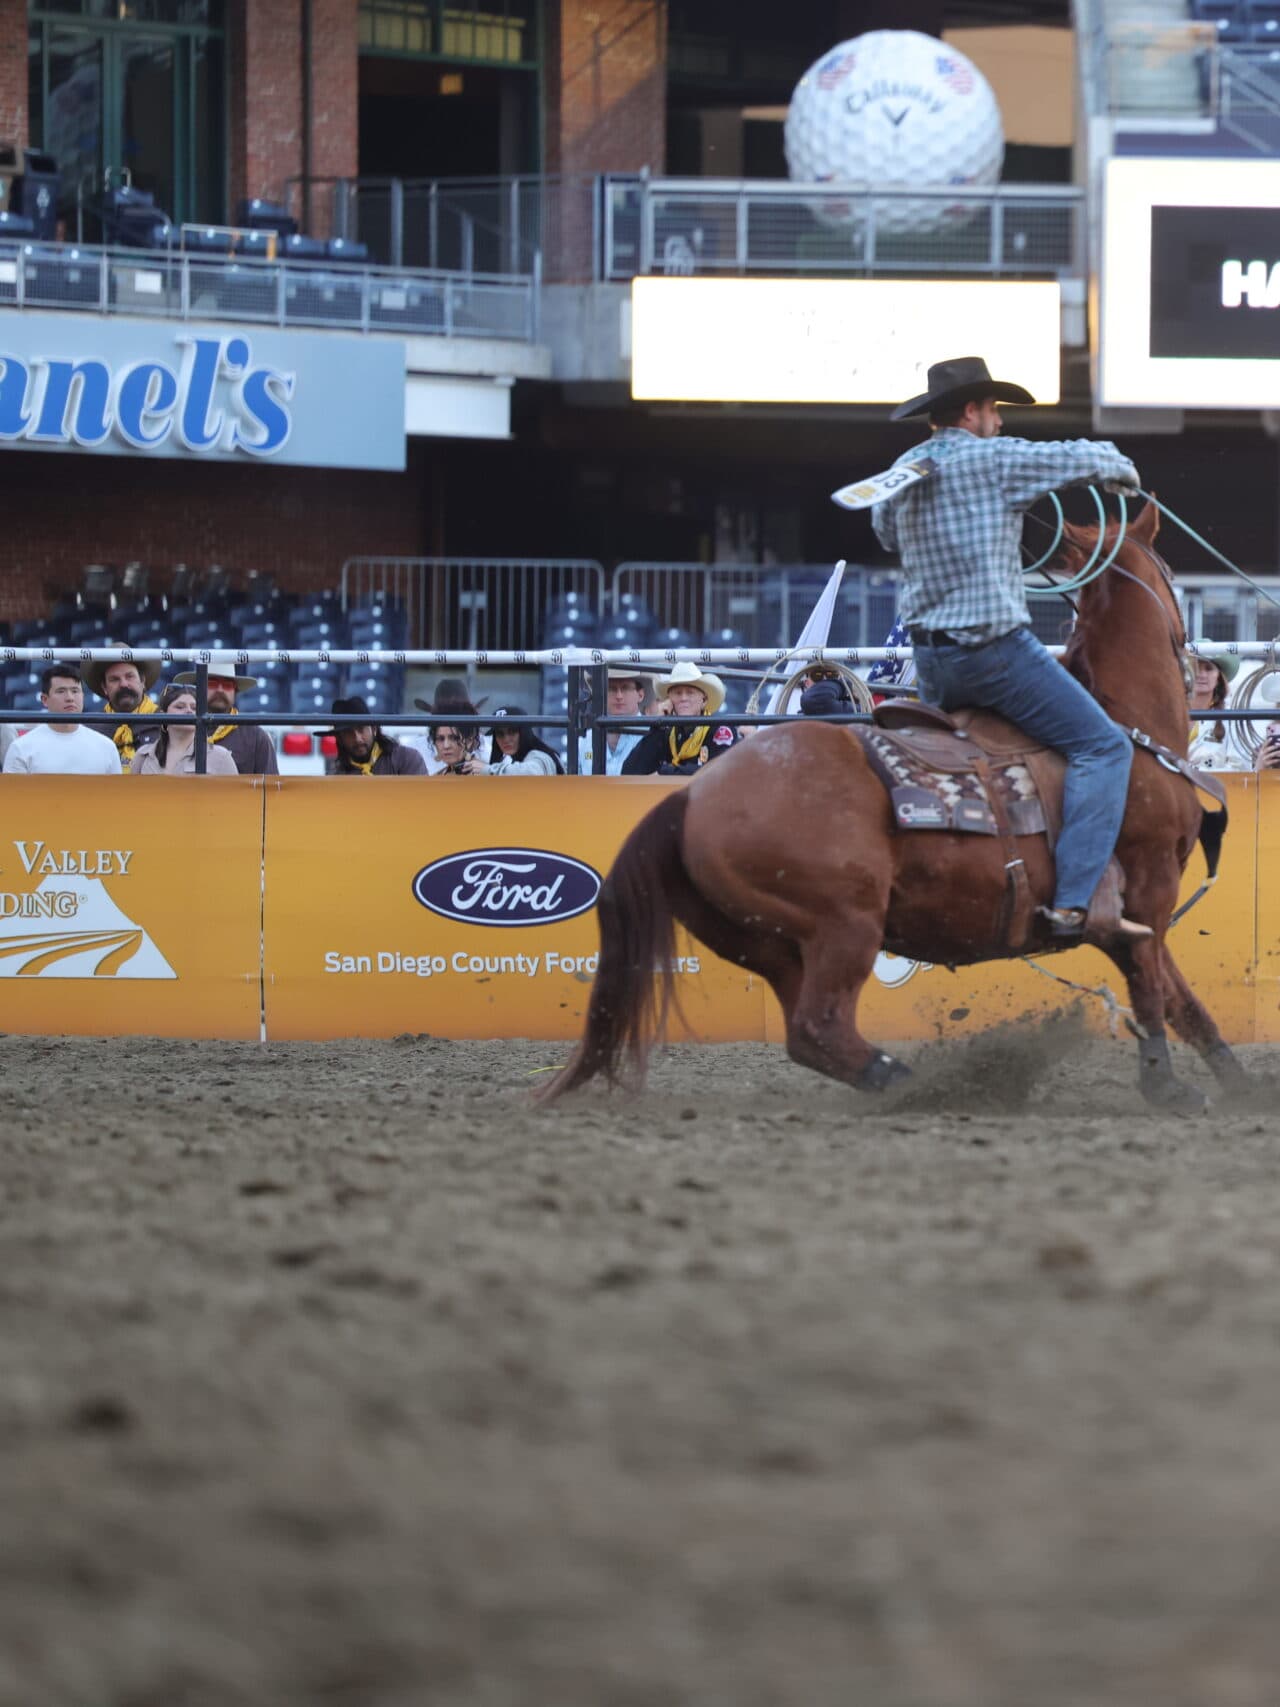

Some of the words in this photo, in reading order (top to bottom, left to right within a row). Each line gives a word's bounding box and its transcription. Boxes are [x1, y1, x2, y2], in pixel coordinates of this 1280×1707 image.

[13, 840, 133, 875] VALLEY
[452, 859, 565, 912] Ford
[324, 951, 372, 973] San
[377, 952, 447, 977] Diego
[451, 952, 540, 977] County
[545, 952, 600, 974] Ford
